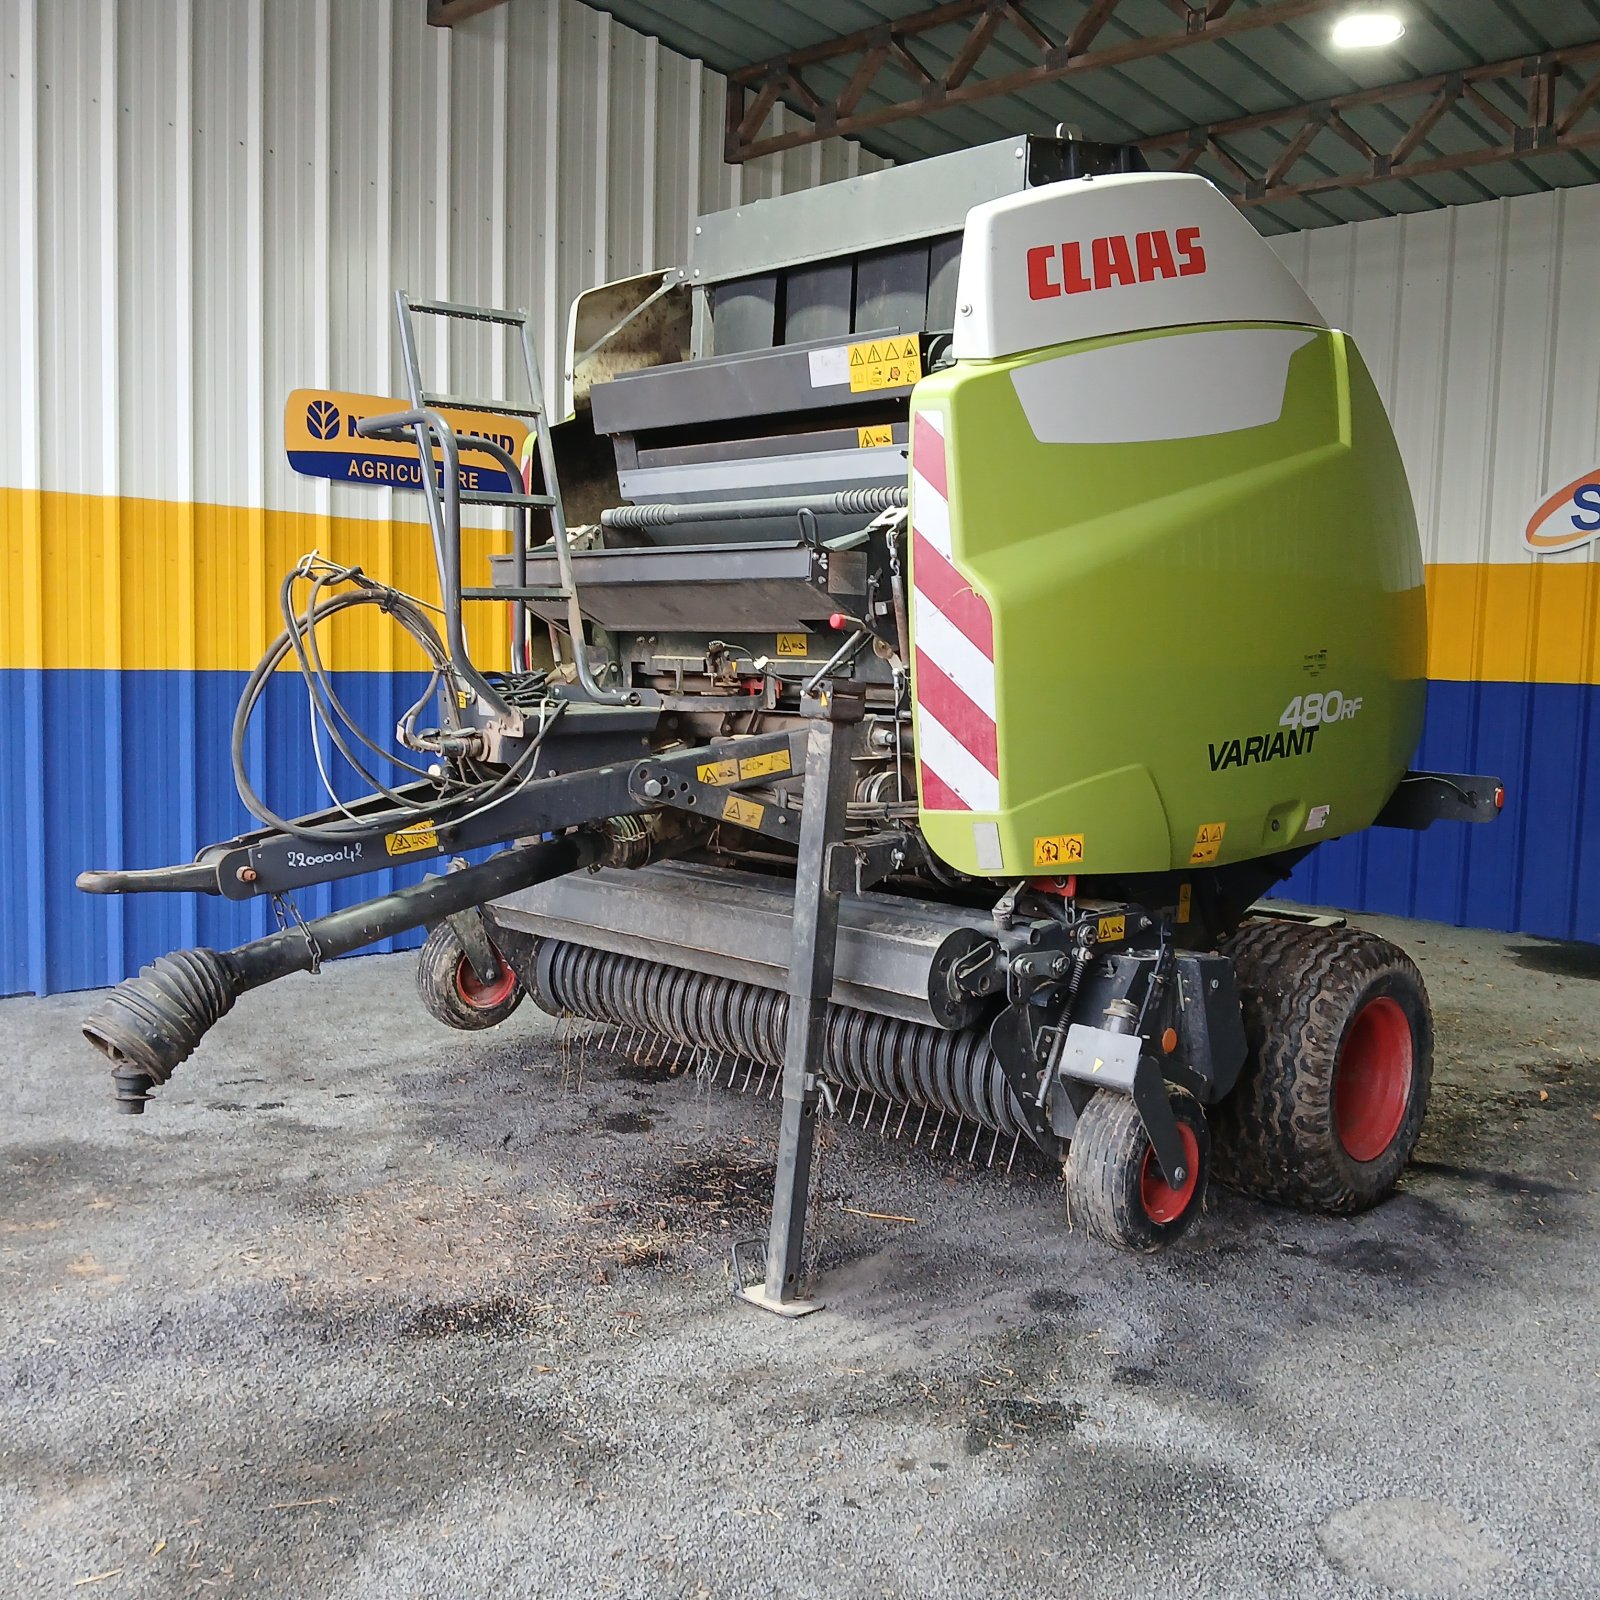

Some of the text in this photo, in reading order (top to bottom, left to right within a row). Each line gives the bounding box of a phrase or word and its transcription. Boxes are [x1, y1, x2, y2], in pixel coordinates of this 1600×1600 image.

[1027, 227, 1206, 300] CLAAS
[348, 459, 479, 490] AGRICUTRE
[1208, 725, 1320, 771] VARIANT
[286, 842, 364, 868] 22000042
